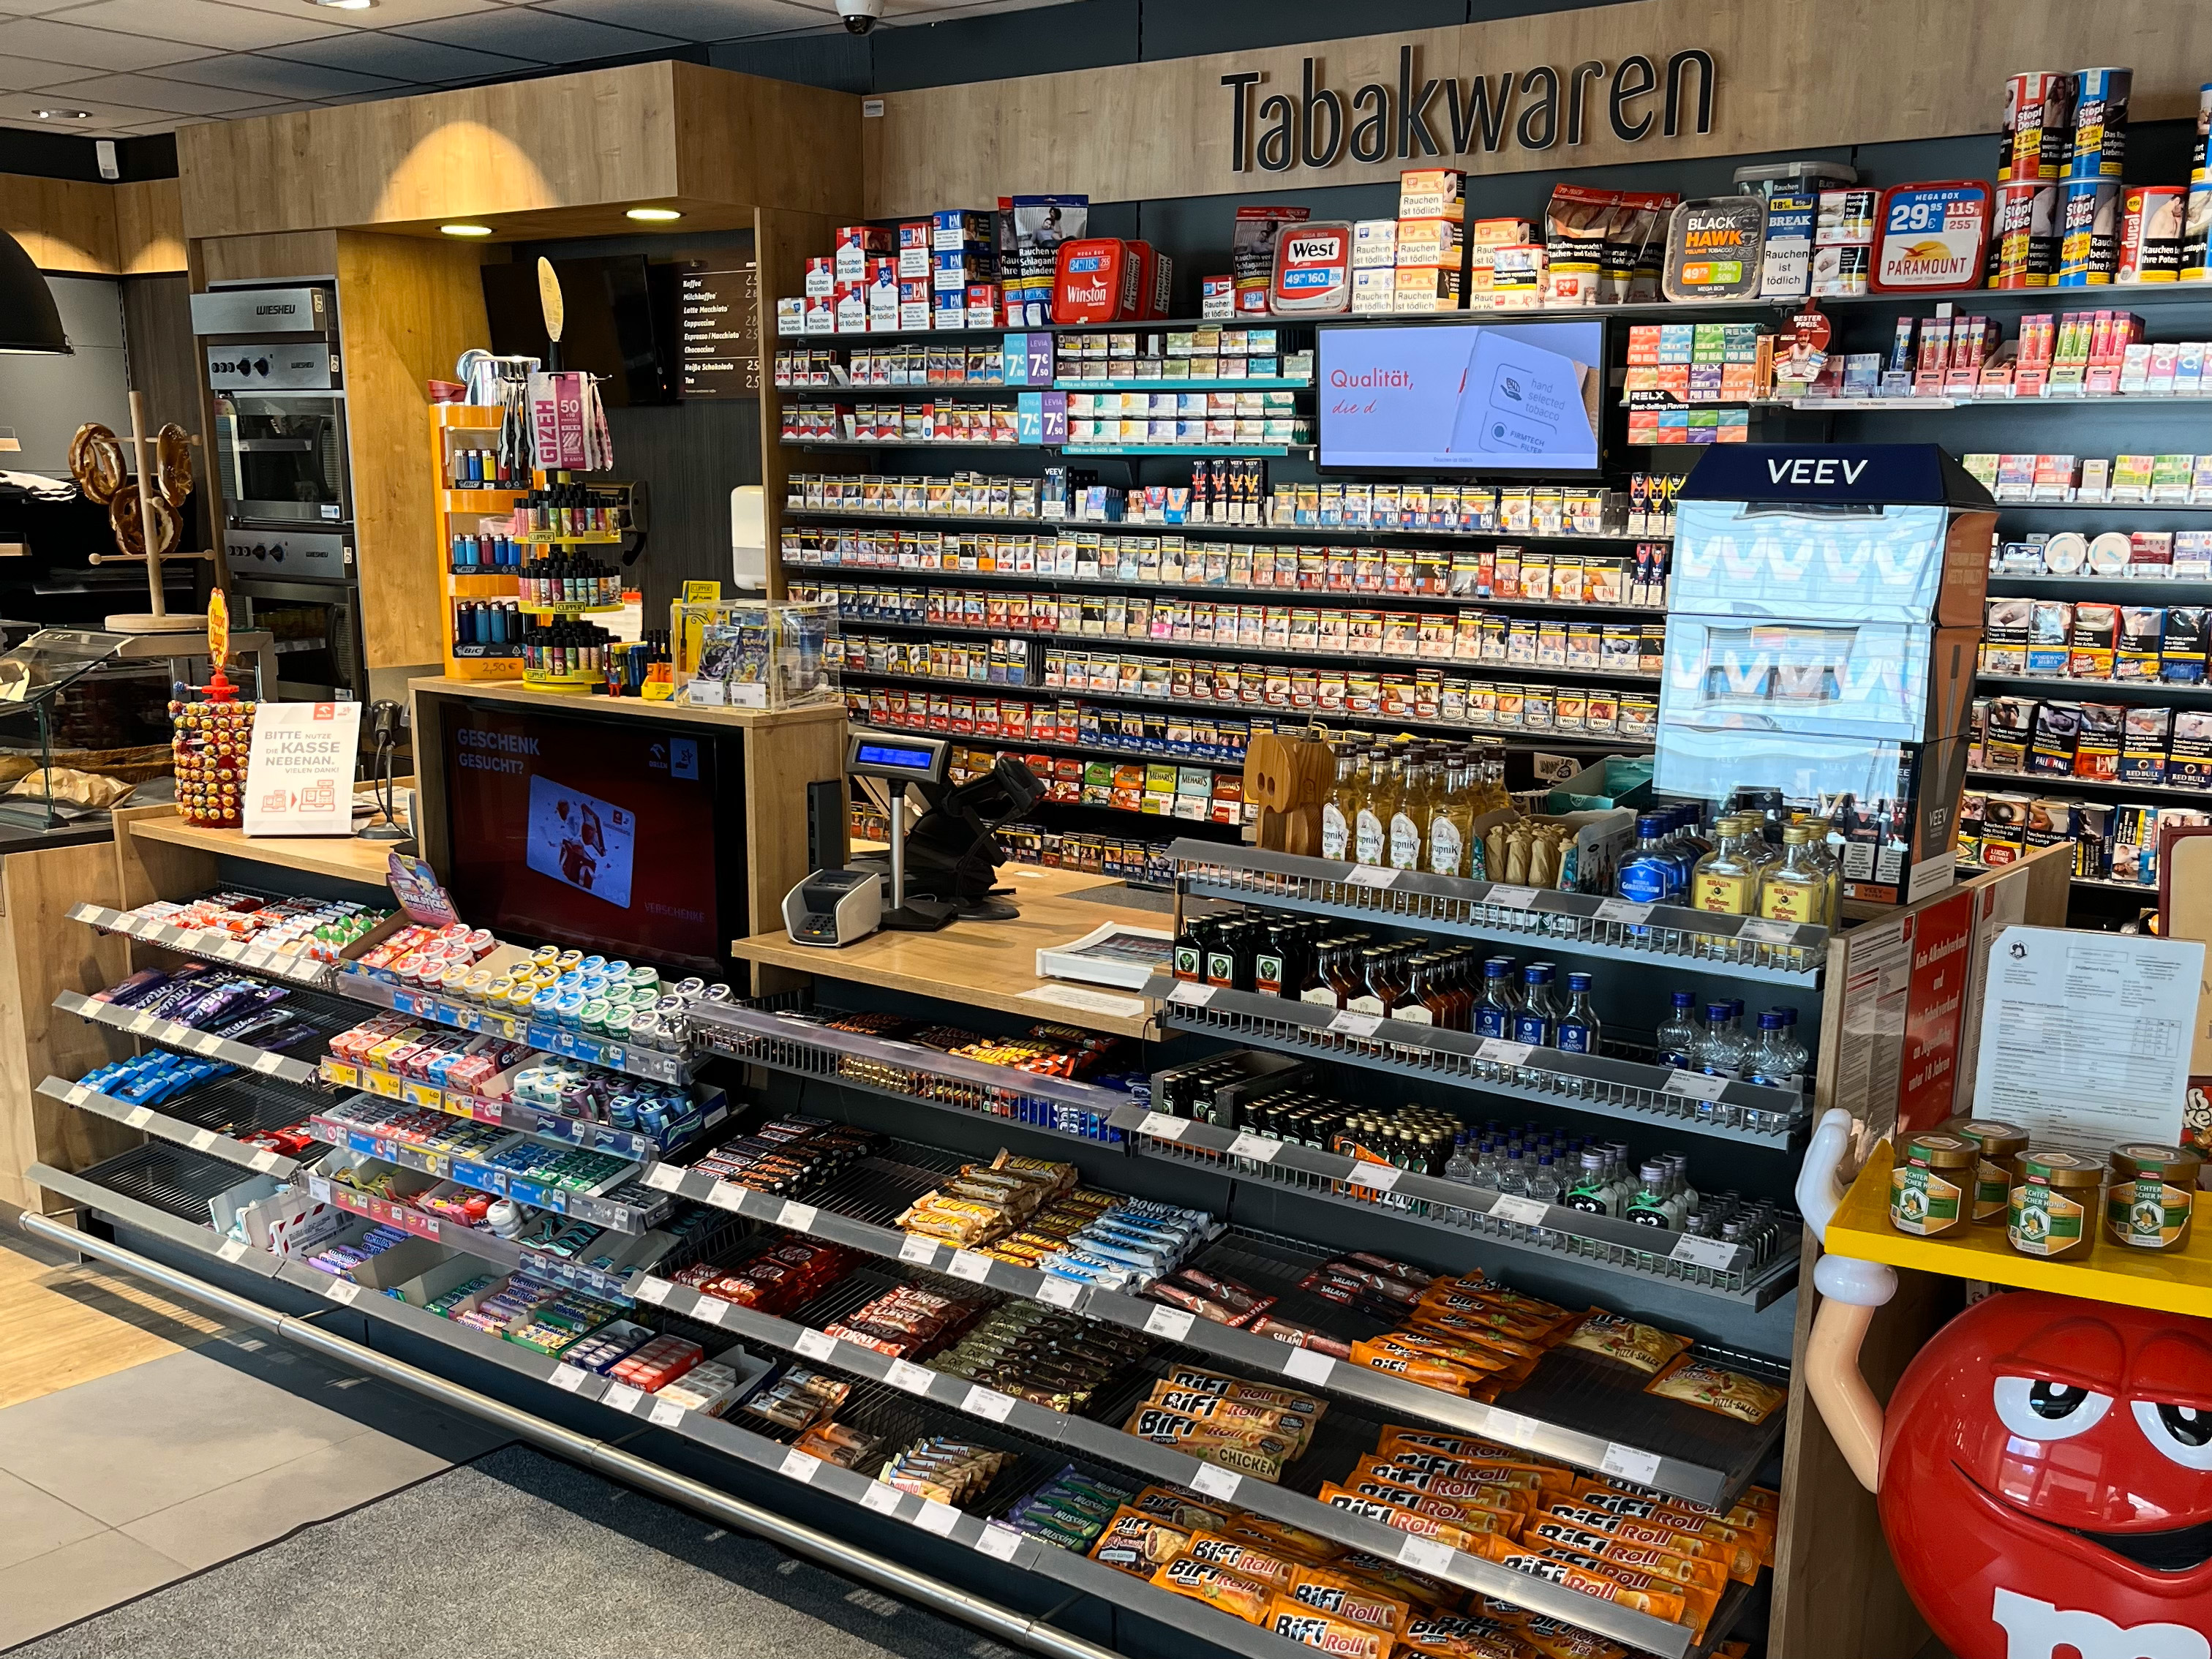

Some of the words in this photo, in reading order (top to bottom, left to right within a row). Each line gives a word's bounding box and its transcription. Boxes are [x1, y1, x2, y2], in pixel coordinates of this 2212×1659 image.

[1220, 45, 1717, 174] Tabakwaren
[2017, 107, 2042, 122] Stopf
[2079, 104, 2104, 118] Stopf
[2017, 118, 2041, 132] Dose
[2079, 115, 2102, 128] Dose
[1404, 197, 1439, 205] Rauchen
[1916, 193, 1938, 201] MEGA
[1412, 206, 1441, 215] tödlich
[2005, 199, 2032, 218] Stopf
[2066, 198, 2095, 216] Stopf
[1688, 217, 1737, 230] BLACK
[1769, 216, 1811, 227] BREAK
[2005, 215, 2030, 231] Dose
[2066, 214, 2092, 229] Dose
[2122, 214, 2141, 248] ducal
[1685, 230, 1742, 247] HAWK
[1293, 241, 1336, 257] West
[1356, 245, 1390, 254] Rauchen
[1401, 245, 1436, 254] Rauchen
[1765, 249, 1808, 259] Rauchen
[1354, 256, 1363, 264] ist
[1364, 255, 1392, 264] tödlich
[1408, 255, 1438, 263] tödlich
[1779, 263, 1791, 272] ist
[1887, 257, 1967, 276] PARAMOUNT
[1767, 276, 1800, 285] tödlich
[1067, 285, 1106, 304] Winston
[1398, 293, 1432, 301] Rauchen
[256, 304, 296, 315] WIESHEU
[699, 305, 729, 314] Macchiato
[1396, 303, 1404, 311] ist
[1405, 302, 1434, 311] tödlich
[1793, 315, 1821, 323] BESTER
[1662, 326, 1690, 334] RELX
[1697, 325, 1726, 333] RELX
[1696, 352, 1707, 361] POD
[1709, 351, 1724, 360] REAL
[1726, 351, 1738, 360] POD
[1739, 350, 1755, 360] REAL
[701, 362, 734, 372] Schokolade
[685, 377, 695, 385] Tee
[1331, 367, 1414, 391] Qualität,
[1531, 379, 1554, 394] hand
[1528, 391, 1565, 410] selected
[1631, 391, 1666, 401] RELX
[560, 399, 579, 413] 50
[1332, 399, 1360, 414] die
[1525, 402, 1560, 422] tobacco
[535, 400, 558, 463] GIZEH
[1510, 430, 1545, 448] FIRMTECH
[1045, 467, 1064, 475] VEEV
[1768, 459, 1868, 484] VEEV
[530, 533, 554, 542] CLIPPER
[691, 584, 713, 592] CLIPPER
[557, 603, 584, 612] CLIPPER
[483, 661, 505, 674] 2,50
[265, 731, 301, 740] BITTE
[457, 729, 541, 756] GESCHENK
[281, 742, 340, 754] KASSE
[266, 756, 334, 766] NEBENAN.
[459, 753, 524, 775] GESUCHT?
[2035, 756, 2049, 767] PALL
[2053, 759, 2068, 771] MALL
[2142, 770, 2159, 778] BULL
[2187, 775, 2206, 783] BULL
[1929, 807, 1949, 827] VEEV
[2143, 816, 2155, 851] DRUM
[1989, 854, 2009, 864] STRIKE
[1990, 849, 2010, 857] LUCKY
[1622, 881, 1660, 893] GORBATSCHOW
[1707, 879, 1731, 888] BRAUN
[1774, 888, 1799, 896] BRAUN
[644, 901, 705, 924] VERSCHENKE
[1915, 951, 1928, 970] Kein
[1928, 929, 1968, 964] Alkoholverkauf
[1933, 969, 1944, 990] und
[129, 984, 173, 1011] Milka
[151, 987, 192, 1016] Milka
[185, 990, 223, 1021] Milka
[1925, 990, 1959, 1021] Tabakverkauf
[1908, 1074, 1924, 1092] unter
[1925, 1064, 1933, 1083] 18
[1933, 1057, 1950, 1078] Jahren
[1011, 1157, 1056, 1171] LION
[1906, 1171, 1928, 1181] ECHTER
[2025, 1189, 2049, 1199] ECHTER
[934, 1197, 982, 1215] LION
[917, 1211, 963, 1227] LION
[364, 1233, 391, 1247] mentos
[331, 1249, 357, 1263] mentos
[511, 1276, 542, 1291] mentos
[1332, 1276, 1361, 1290] SALAMI
[899, 1290, 951, 1307] CORNY
[1320, 1285, 1350, 1298] SALAMI
[536, 1323, 568, 1337] mentos
[834, 1326, 881, 1350] CORNY
[1274, 1333, 1304, 1347] SALAMI
[1614, 1348, 1661, 1368] PIZZA-SNACK
[1007, 1380, 1025, 1396] bel
[1161, 1391, 1222, 1418] BiFi
[1712, 1398, 1762, 1418] PIZZA-SNACK
[1138, 1409, 1202, 1437] BiFi
[1219, 1448, 1279, 1478] CHICKEN
[889, 1478, 922, 1494] hanuta
[1432, 1477, 1481, 1497] Roll
[1620, 1524, 1671, 1547] Roll
[1609, 1545, 1660, 1567] Roll
[1295, 1584, 1347, 1613] BiFi
[1342, 1601, 1382, 1624] Roll
[1276, 1614, 1328, 1645] BiFi
[1323, 1634, 1365, 1655] Roll
[1570, 1641, 1593, 1656] Hot
